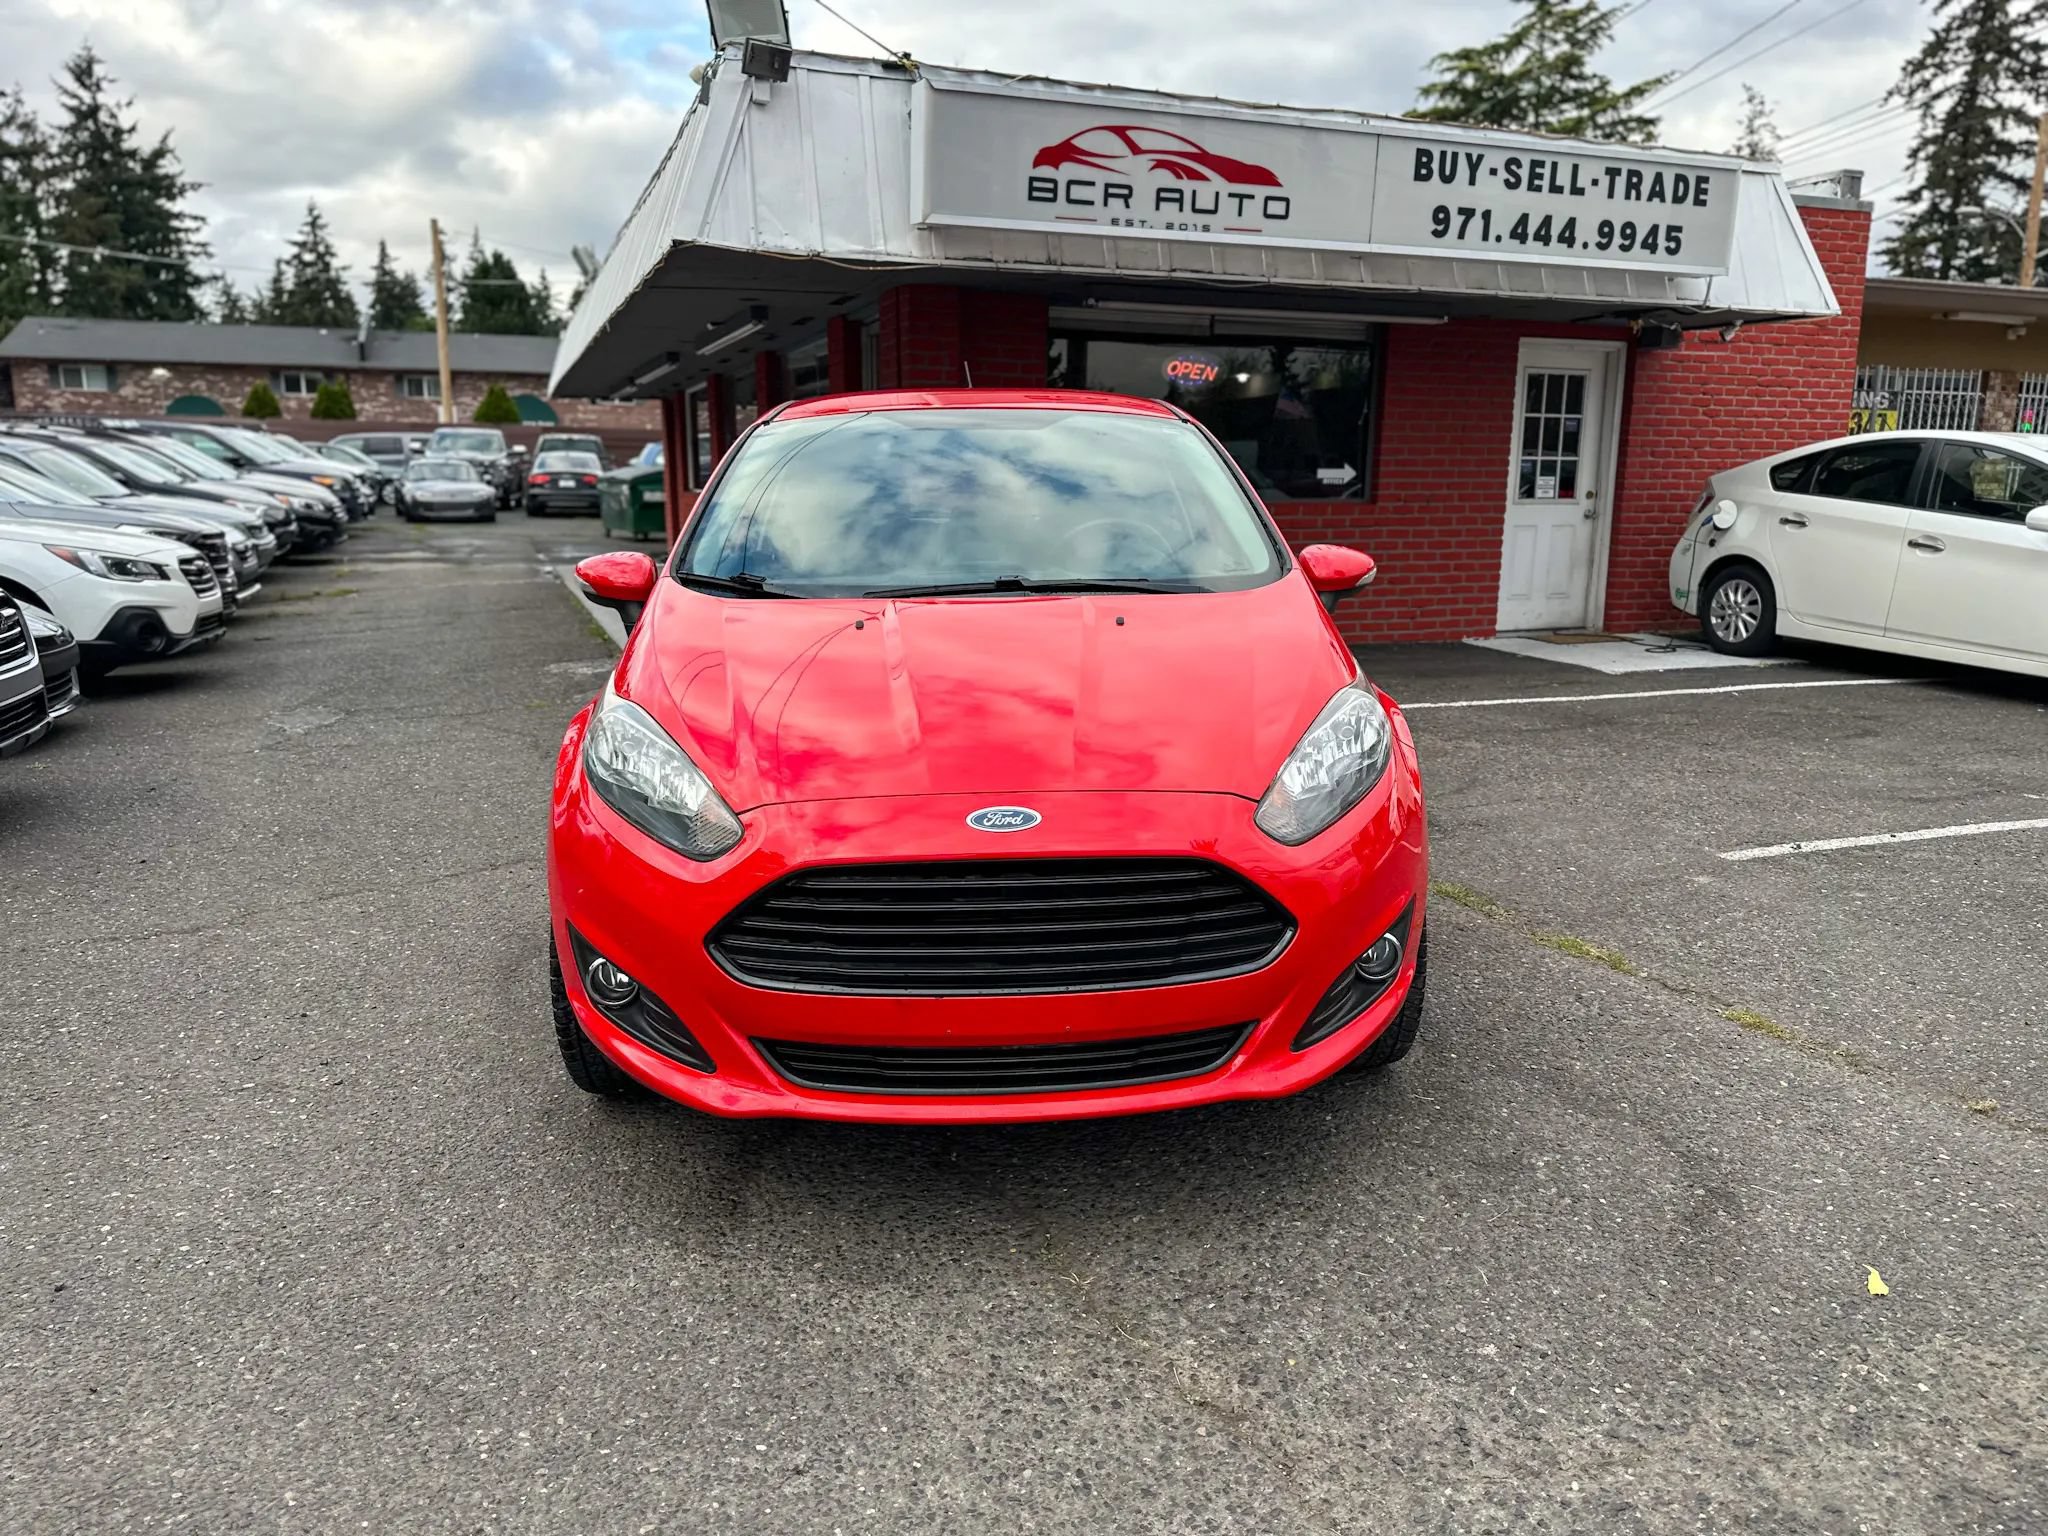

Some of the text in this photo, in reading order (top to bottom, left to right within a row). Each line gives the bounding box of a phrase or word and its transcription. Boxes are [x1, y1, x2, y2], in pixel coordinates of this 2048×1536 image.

[1027, 175, 1291, 221] BCR AUTO
[1110, 217, 1211, 233] EST. 2015
[1430, 204, 1684, 257] 971.444.9945
[1167, 359, 1219, 382] OPEN
[983, 811, 1024, 826] Ford
